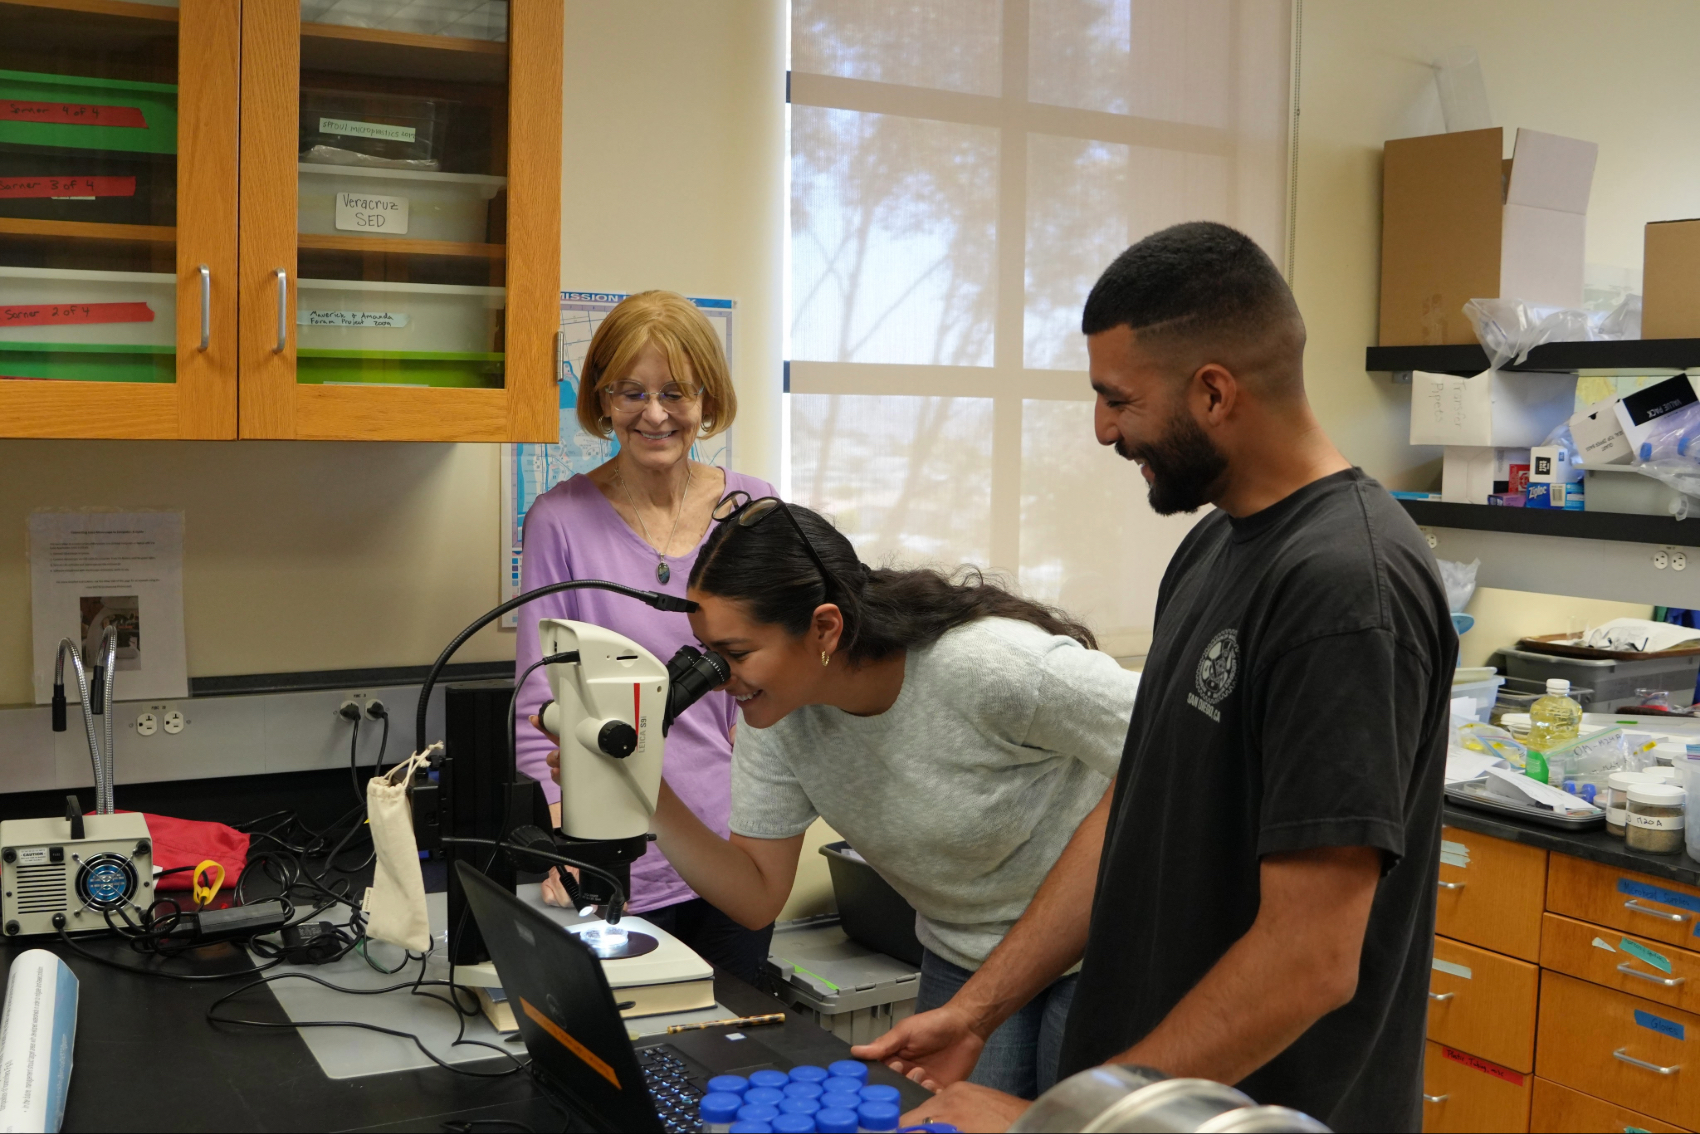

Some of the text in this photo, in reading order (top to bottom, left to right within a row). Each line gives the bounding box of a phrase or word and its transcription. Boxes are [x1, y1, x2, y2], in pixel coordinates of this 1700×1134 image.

[62, 105, 69, 115] 4
[74, 107, 86, 116] of
[92, 107, 99, 119] 4
[50, 180, 59, 190] 3
[63, 180, 77, 190] of
[86, 180, 94, 192] 4
[343, 193, 399, 210] Veracruz
[355, 212, 386, 228] SED
[52, 307, 59, 317] 2
[63, 305, 78, 316] of
[82, 306, 90, 317] 4
[361, 312, 394, 320] Amanda
[1453, 379, 1467, 427] Transfer
[1646, 405, 1664, 419] PACK
[1528, 485, 1547, 500] Ziploc
[638, 730, 646, 754] LEICA
[1651, 1017, 1679, 1036] Gloves
